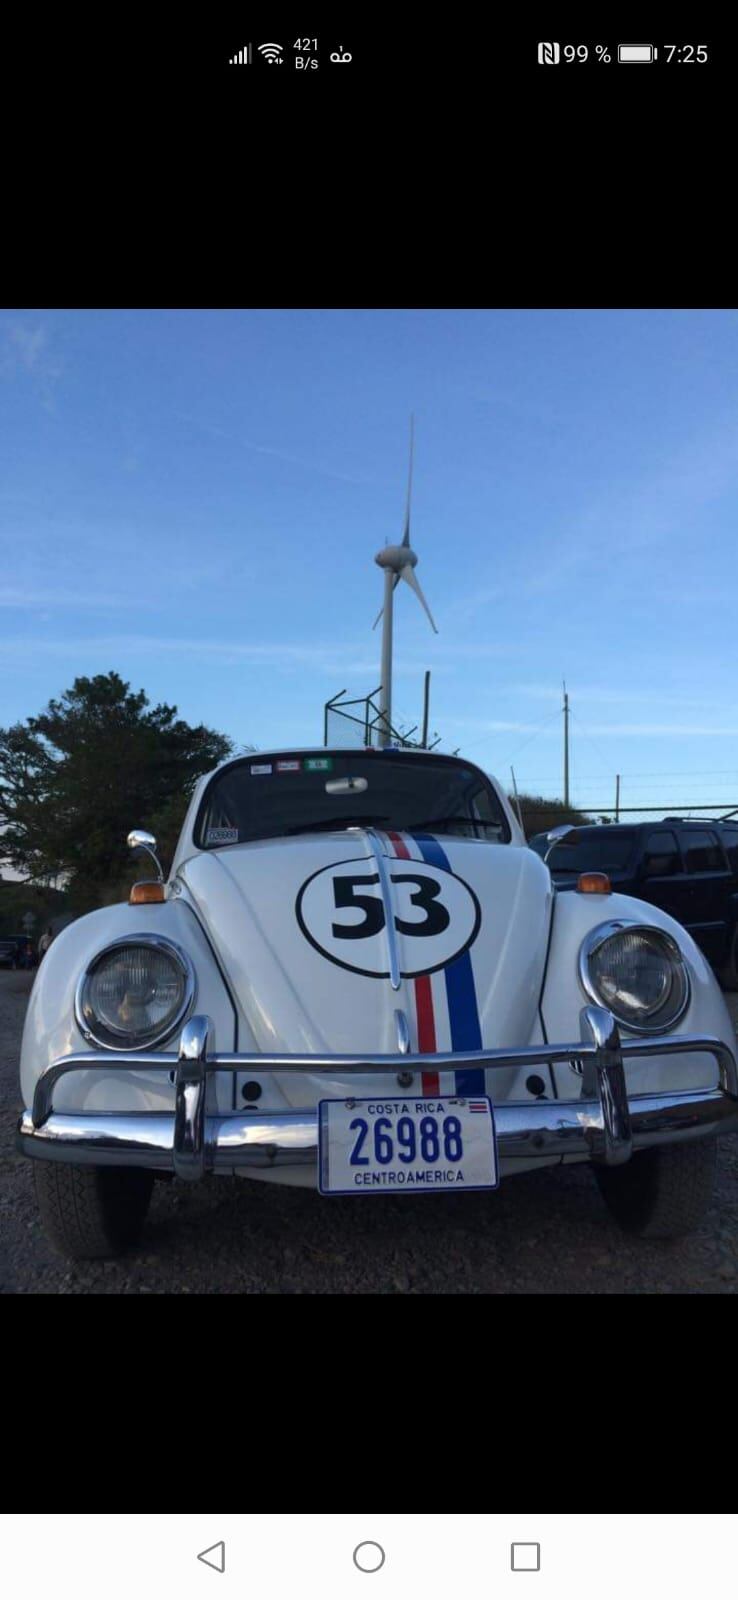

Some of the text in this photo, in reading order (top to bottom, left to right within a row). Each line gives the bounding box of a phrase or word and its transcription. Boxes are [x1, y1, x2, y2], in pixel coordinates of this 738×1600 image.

[331, 873, 450, 940] 53
[367, 1101, 445, 1115] COSTA RICA
[349, 1115, 463, 1166] 26988
[354, 1170, 465, 1185] CENTROAMERICA
